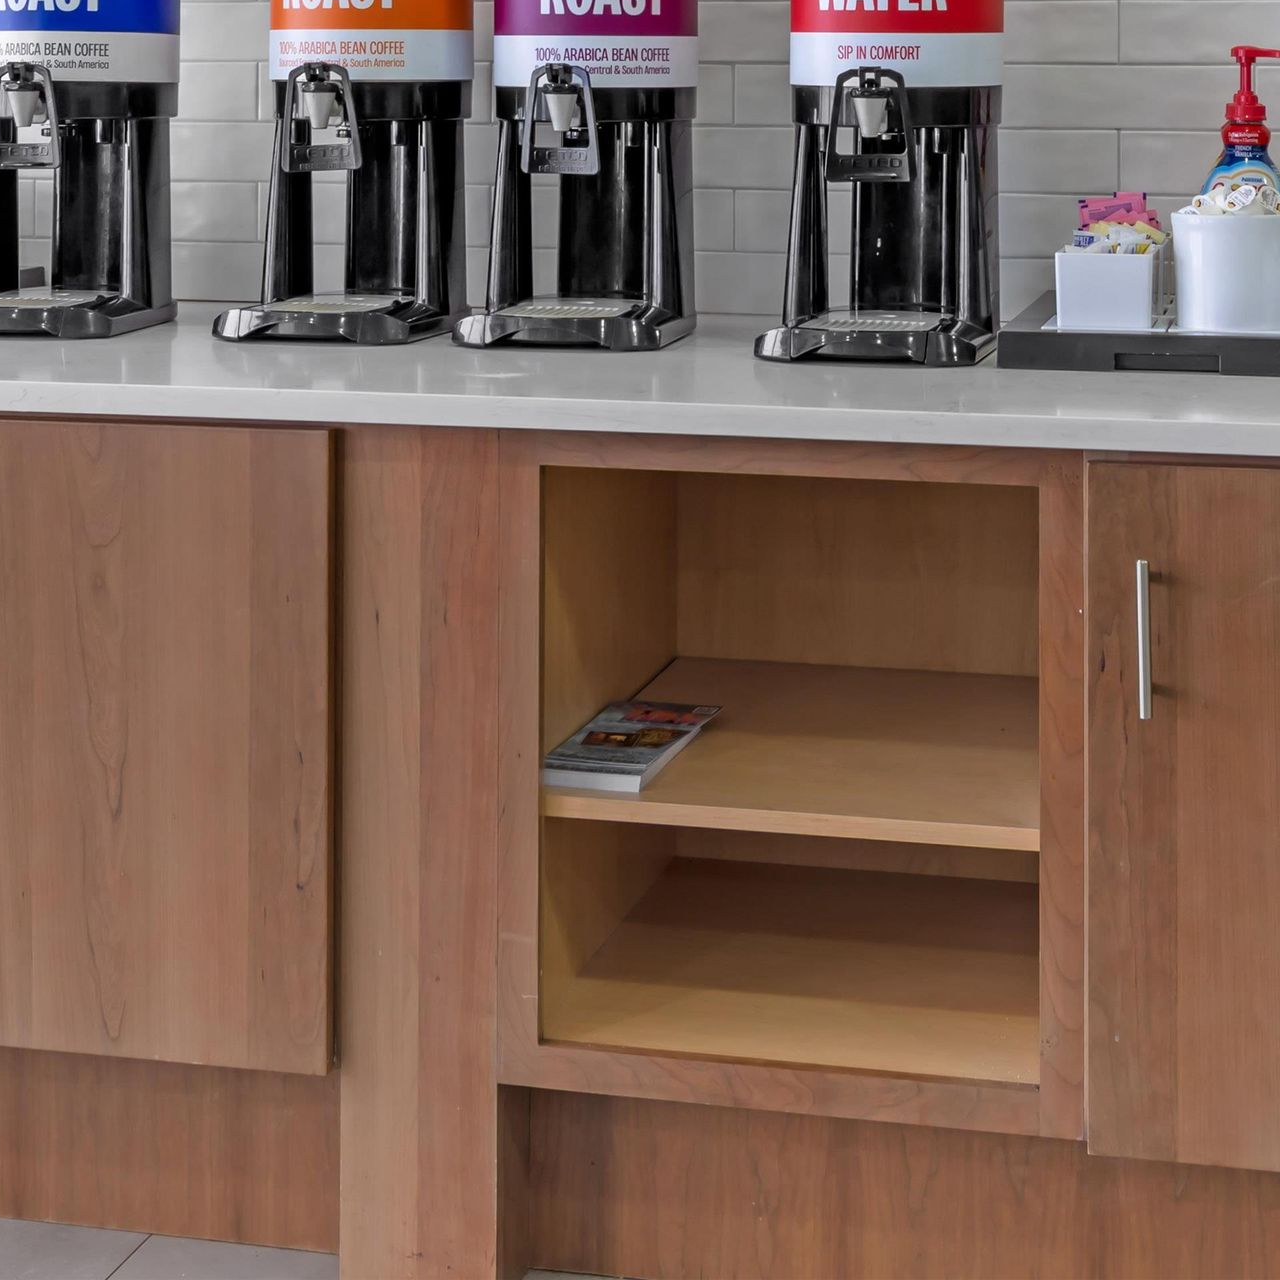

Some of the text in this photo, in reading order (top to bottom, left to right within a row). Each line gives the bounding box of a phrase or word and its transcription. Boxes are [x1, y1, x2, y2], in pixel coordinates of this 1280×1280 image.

[5, 43, 41, 56] ARABICA
[44, 43, 71, 56] BEAN
[74, 43, 109, 57] COFFEE
[299, 41, 337, 55] ARABICA
[340, 41, 367, 55] BEAN
[370, 41, 405, 55] COFFEE
[535, 47, 670, 62] 100% ARABICA BEAN COFFEE
[837, 45, 921, 60] SIP IN COMFORT
[46, 60, 53, 68] &
[54, 60, 76, 69] South
[78, 61, 109, 69] America
[342, 58, 349, 67] &
[350, 58, 373, 68] South
[374, 58, 405, 68] America
[585, 65, 671, 75] Central & South America
